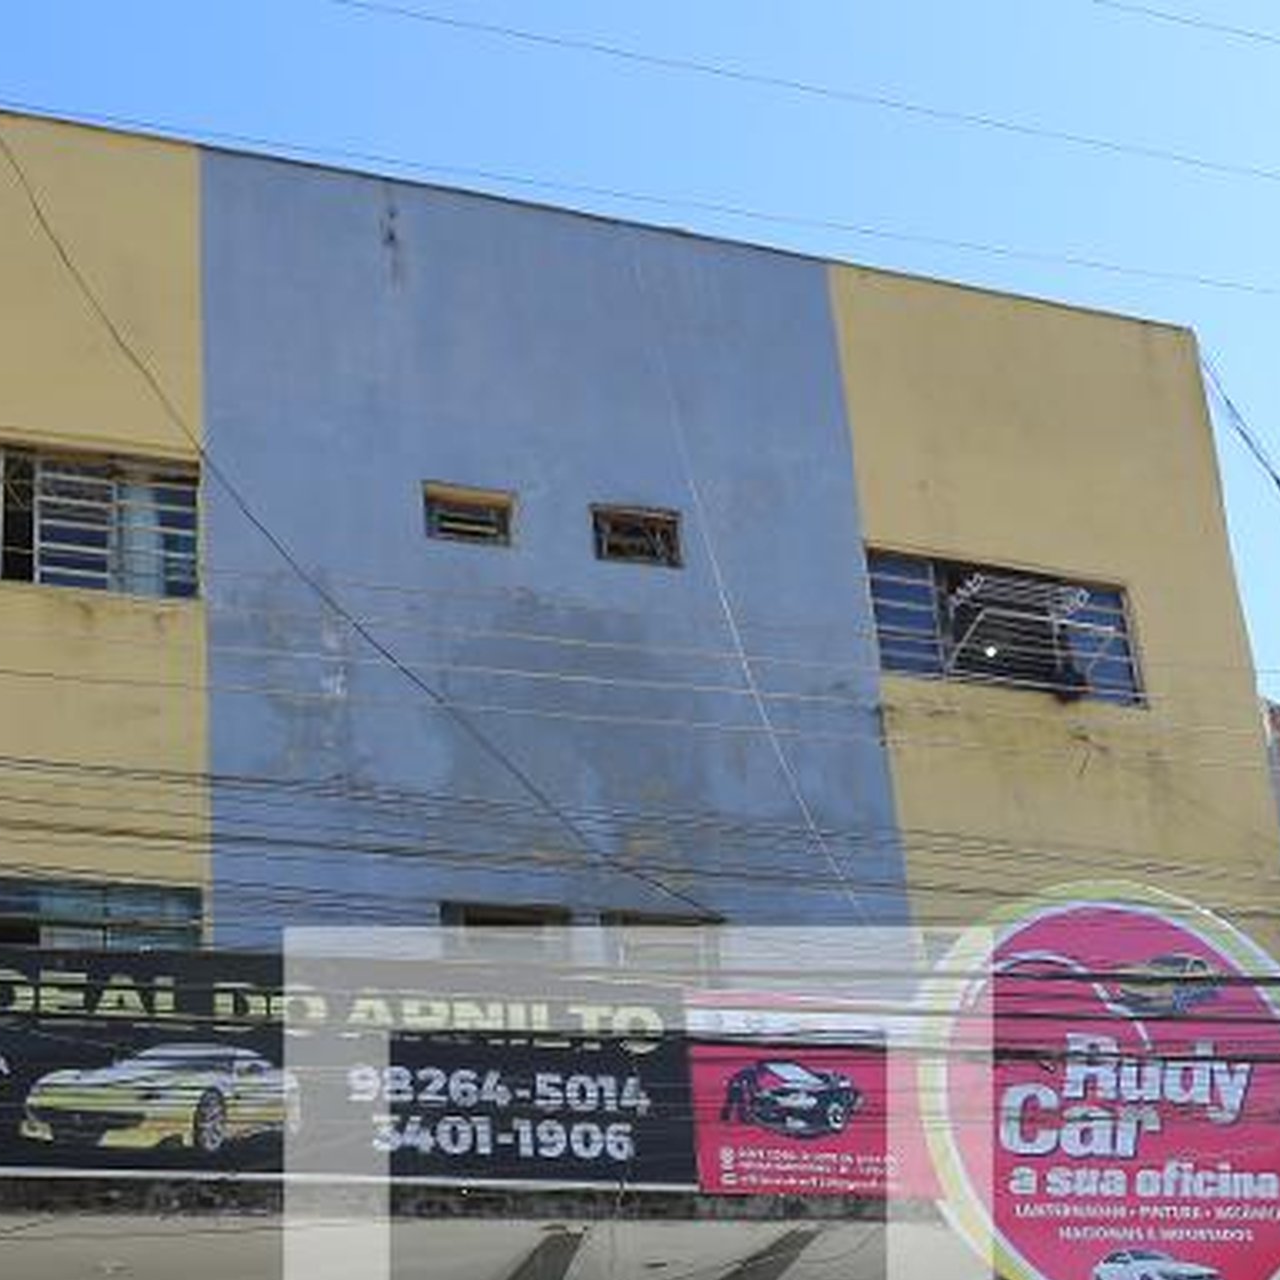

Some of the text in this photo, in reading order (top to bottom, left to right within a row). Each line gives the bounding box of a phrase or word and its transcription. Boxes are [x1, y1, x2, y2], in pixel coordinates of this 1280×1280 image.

[213, 982, 329, 1037] DO
[347, 1065, 652, 1115] 98264-5014
[1064, 1032, 1251, 1122] Rudy
[371, 1114, 636, 1161] 3401-1906
[999, 1083, 1161, 1158] Car
[1008, 1159, 1280, 1200] a sua oficina
